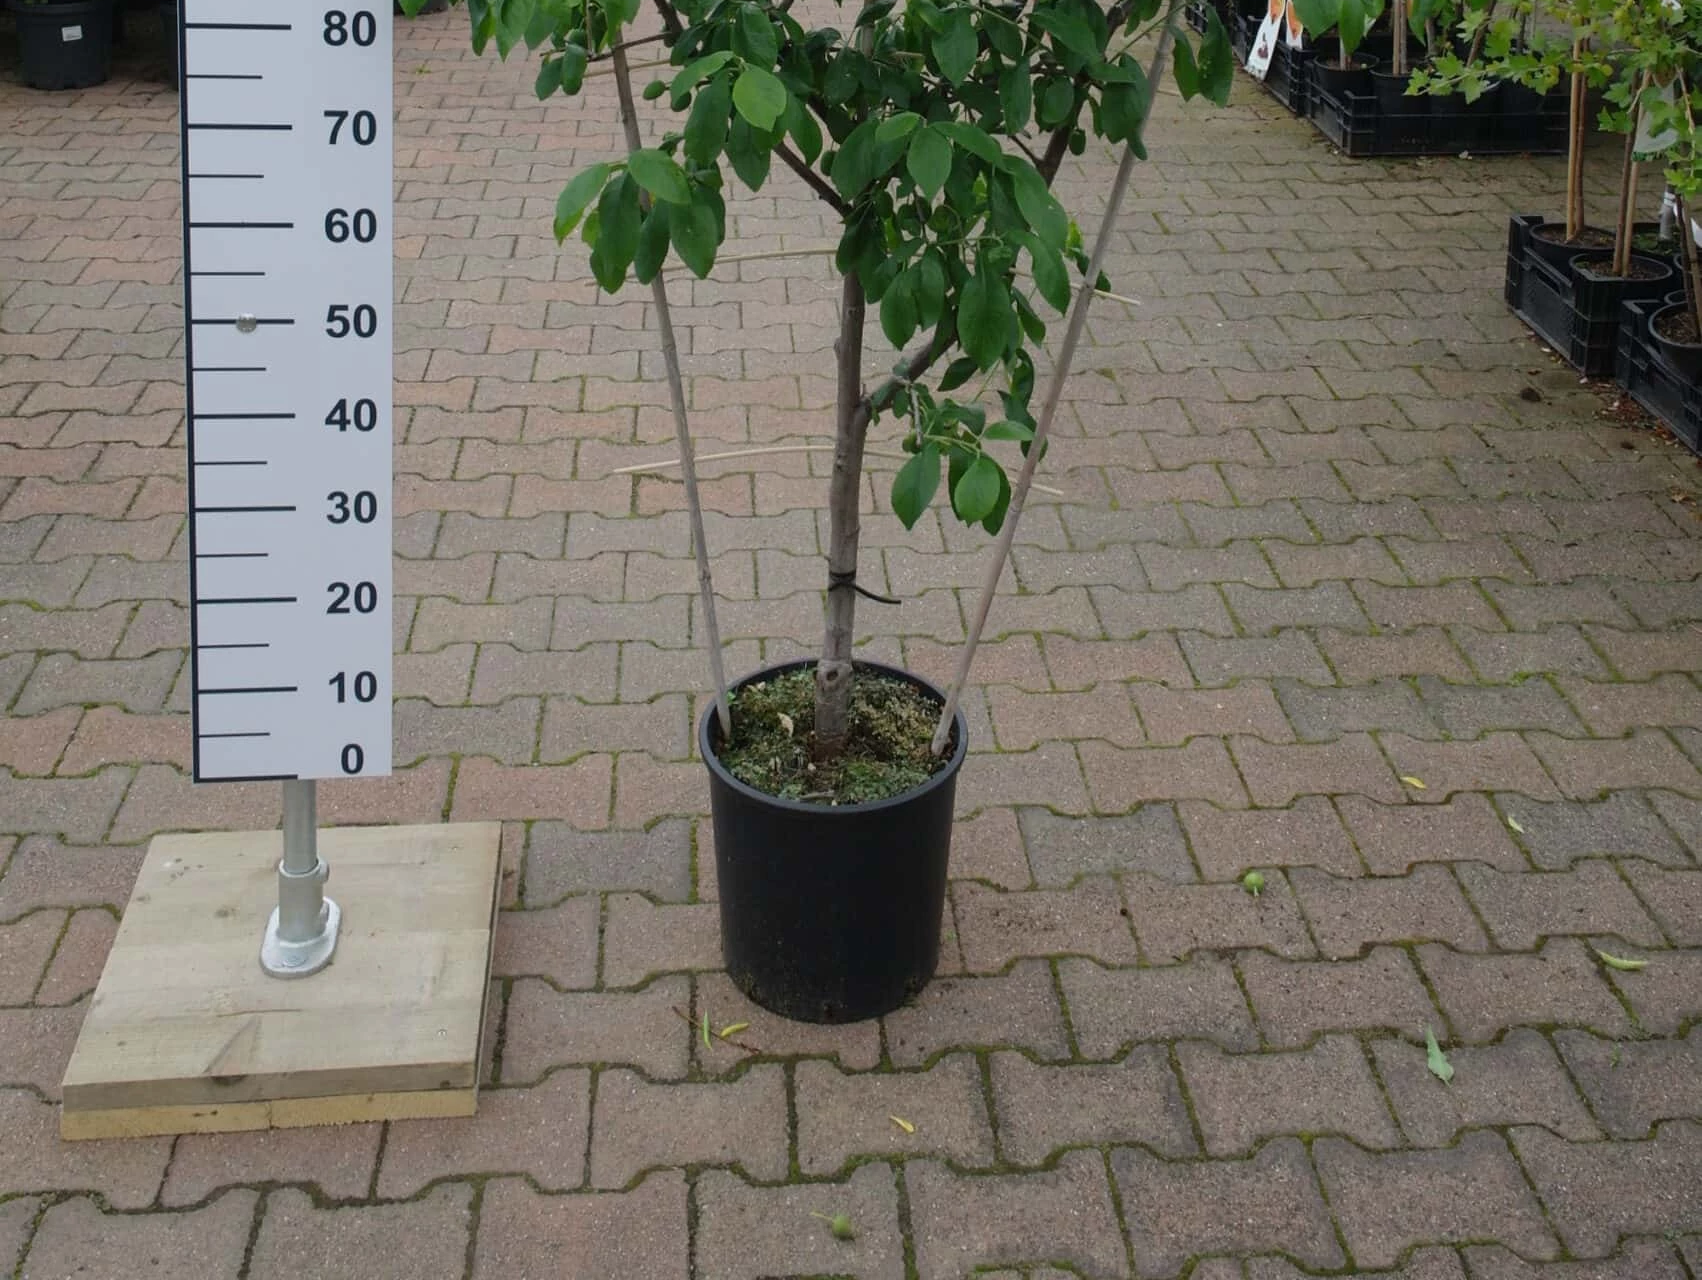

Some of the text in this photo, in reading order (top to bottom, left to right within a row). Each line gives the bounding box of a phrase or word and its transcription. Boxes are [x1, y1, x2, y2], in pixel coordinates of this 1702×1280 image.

[324, 10, 376, 46] 80
[324, 110, 376, 145] 70
[325, 208, 376, 243] 60
[326, 304, 377, 338] 50
[325, 399, 377, 431] 40
[327, 491, 377, 524] 30
[327, 582, 377, 614] 20
[329, 671, 377, 703] 10
[341, 744, 363, 774] 0
